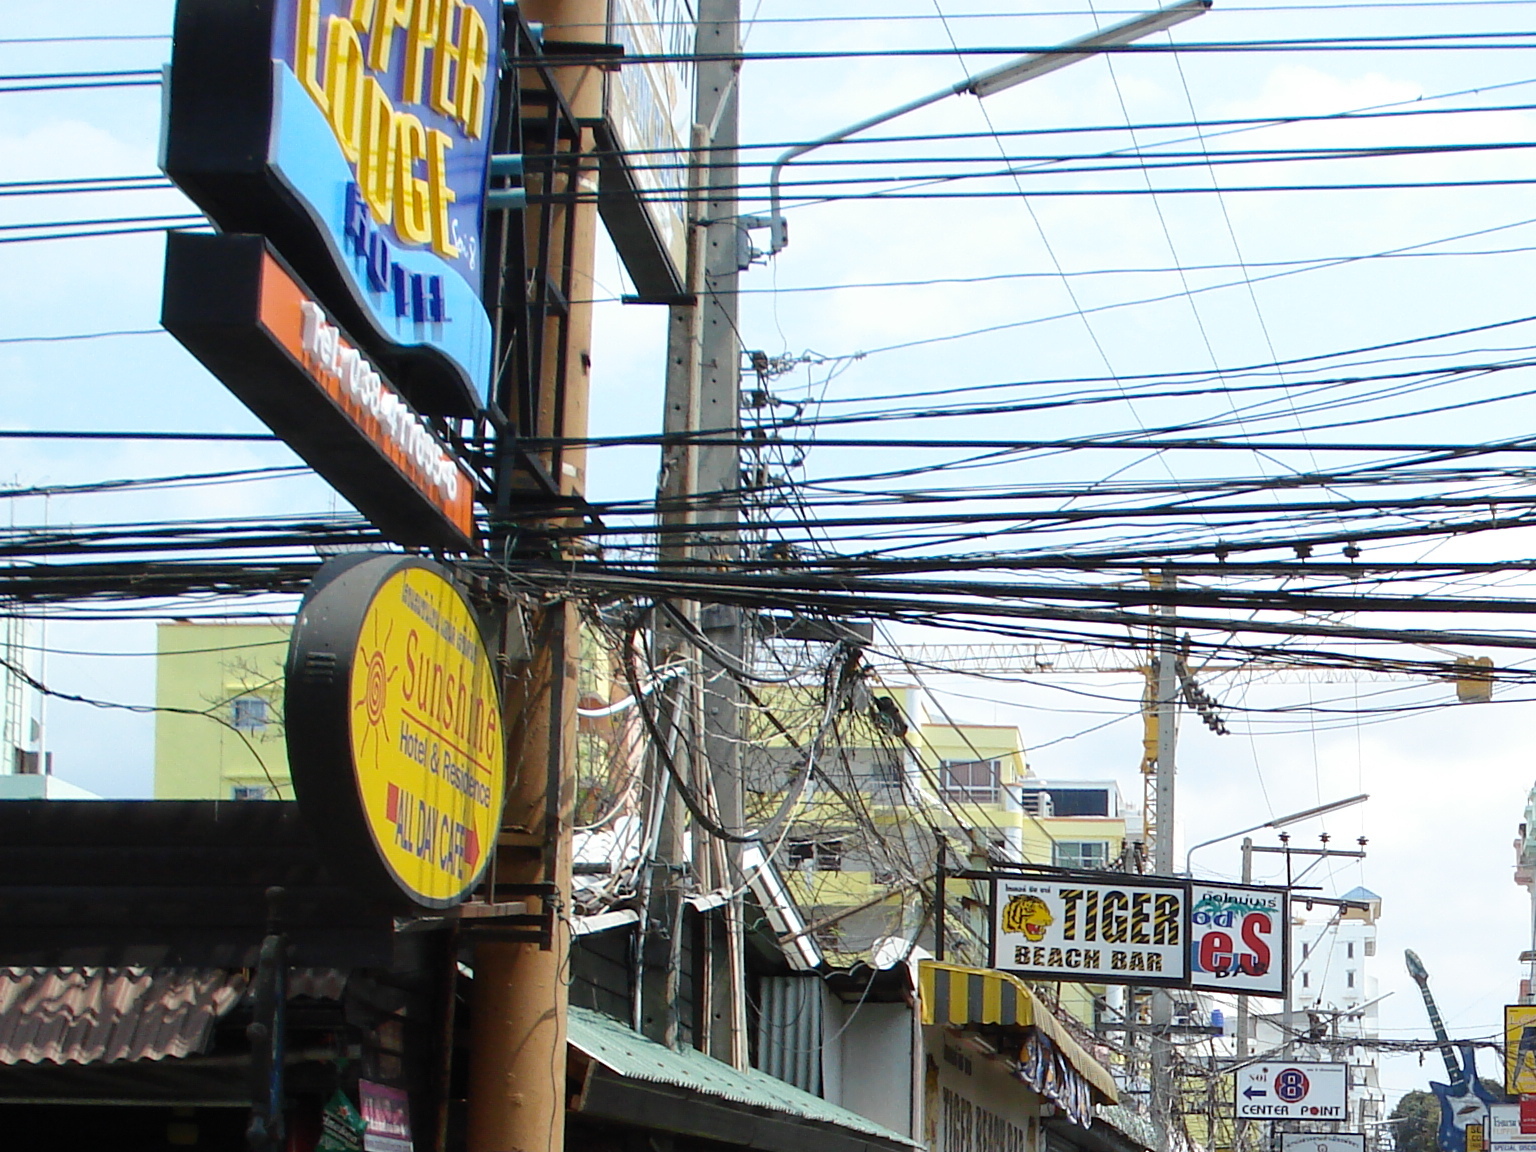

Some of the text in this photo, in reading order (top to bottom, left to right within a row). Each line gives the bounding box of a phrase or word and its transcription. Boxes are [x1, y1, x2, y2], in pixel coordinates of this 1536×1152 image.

[345, 180, 453, 324] HOTEL
[401, 628, 497, 761] Sunshine
[399, 719, 491, 810] Hotel & Residence
[394, 788, 466, 881] ALL DAY CAFE
[1015, 945, 1163, 972] BEACH BAR
[1059, 888, 1180, 946] TIGER
[1242, 1105, 1341, 1116] CENTER POINT
